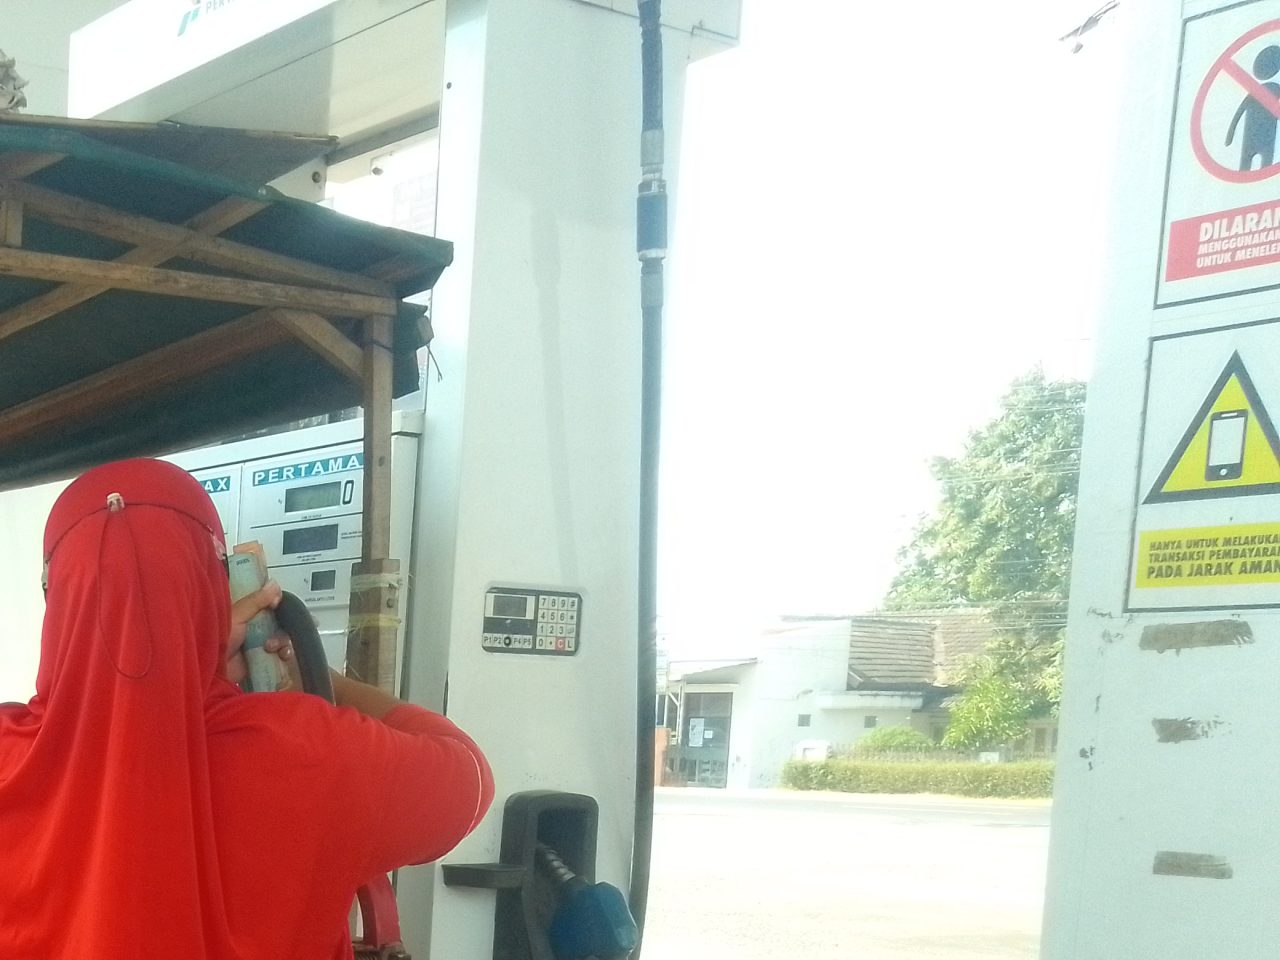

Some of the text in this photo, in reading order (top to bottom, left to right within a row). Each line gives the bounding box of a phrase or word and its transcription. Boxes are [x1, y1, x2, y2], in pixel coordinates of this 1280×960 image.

[1197, 252, 1232, 268] UNTUK
[254, 455, 360, 485] PERTAMA
[1149, 540, 1182, 551] HANYA
[1186, 537, 1219, 549] UNTUK
[1149, 546, 1280, 563] TRANSAKSI PEMBAYARA
[1147, 564, 1182, 579] PADA
[1187, 562, 1233, 577] JARAK
